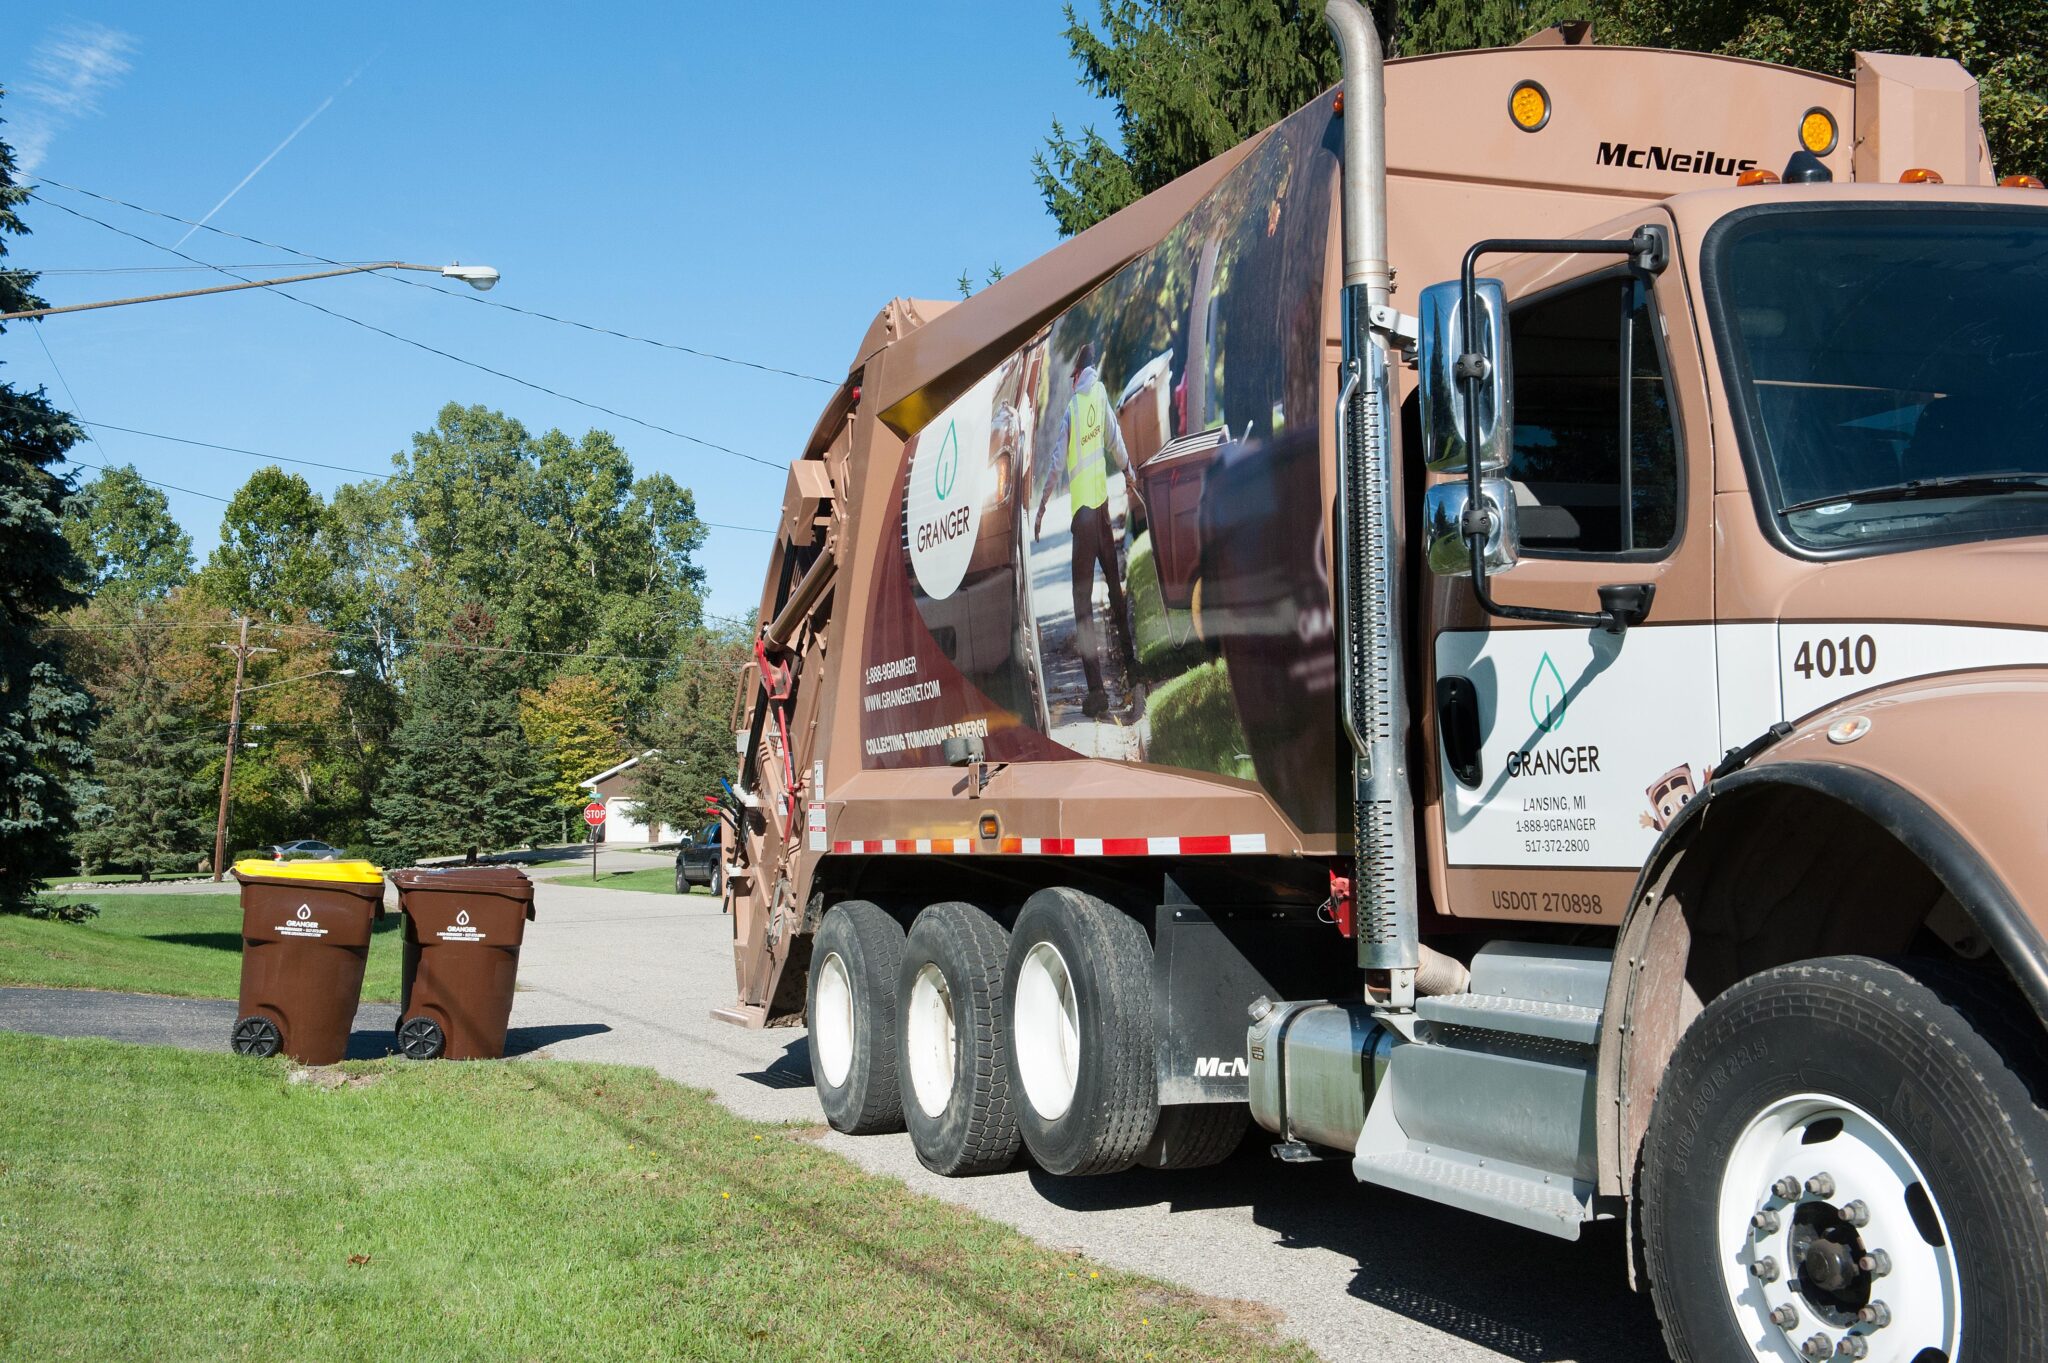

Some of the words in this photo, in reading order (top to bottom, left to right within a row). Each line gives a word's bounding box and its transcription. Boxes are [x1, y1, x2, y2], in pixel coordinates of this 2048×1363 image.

[1596, 142, 1757, 177] McNeilus
[917, 505, 970, 553] GRANGER
[865, 656, 917, 685] 1-888-9GRANGER
[1793, 634, 1877, 680] 4010
[863, 680, 941, 712] WWW.GRANGERNET.COM
[866, 734, 906, 755] COLLECTING
[955, 718, 989, 740] ENERGY
[1506, 745, 1601, 778] GRANGER
[586, 809, 606, 819] STOP
[1523, 796, 1571, 812] LANSING,
[1573, 795, 1586, 810] MI
[1515, 818, 1597, 833] 1-888-9GRANGER
[1525, 839, 1590, 853] 517-372-2800
[1492, 890, 1539, 911] USDOT
[1542, 893, 1603, 915] 270898
[286, 920, 319, 929] GRANGER
